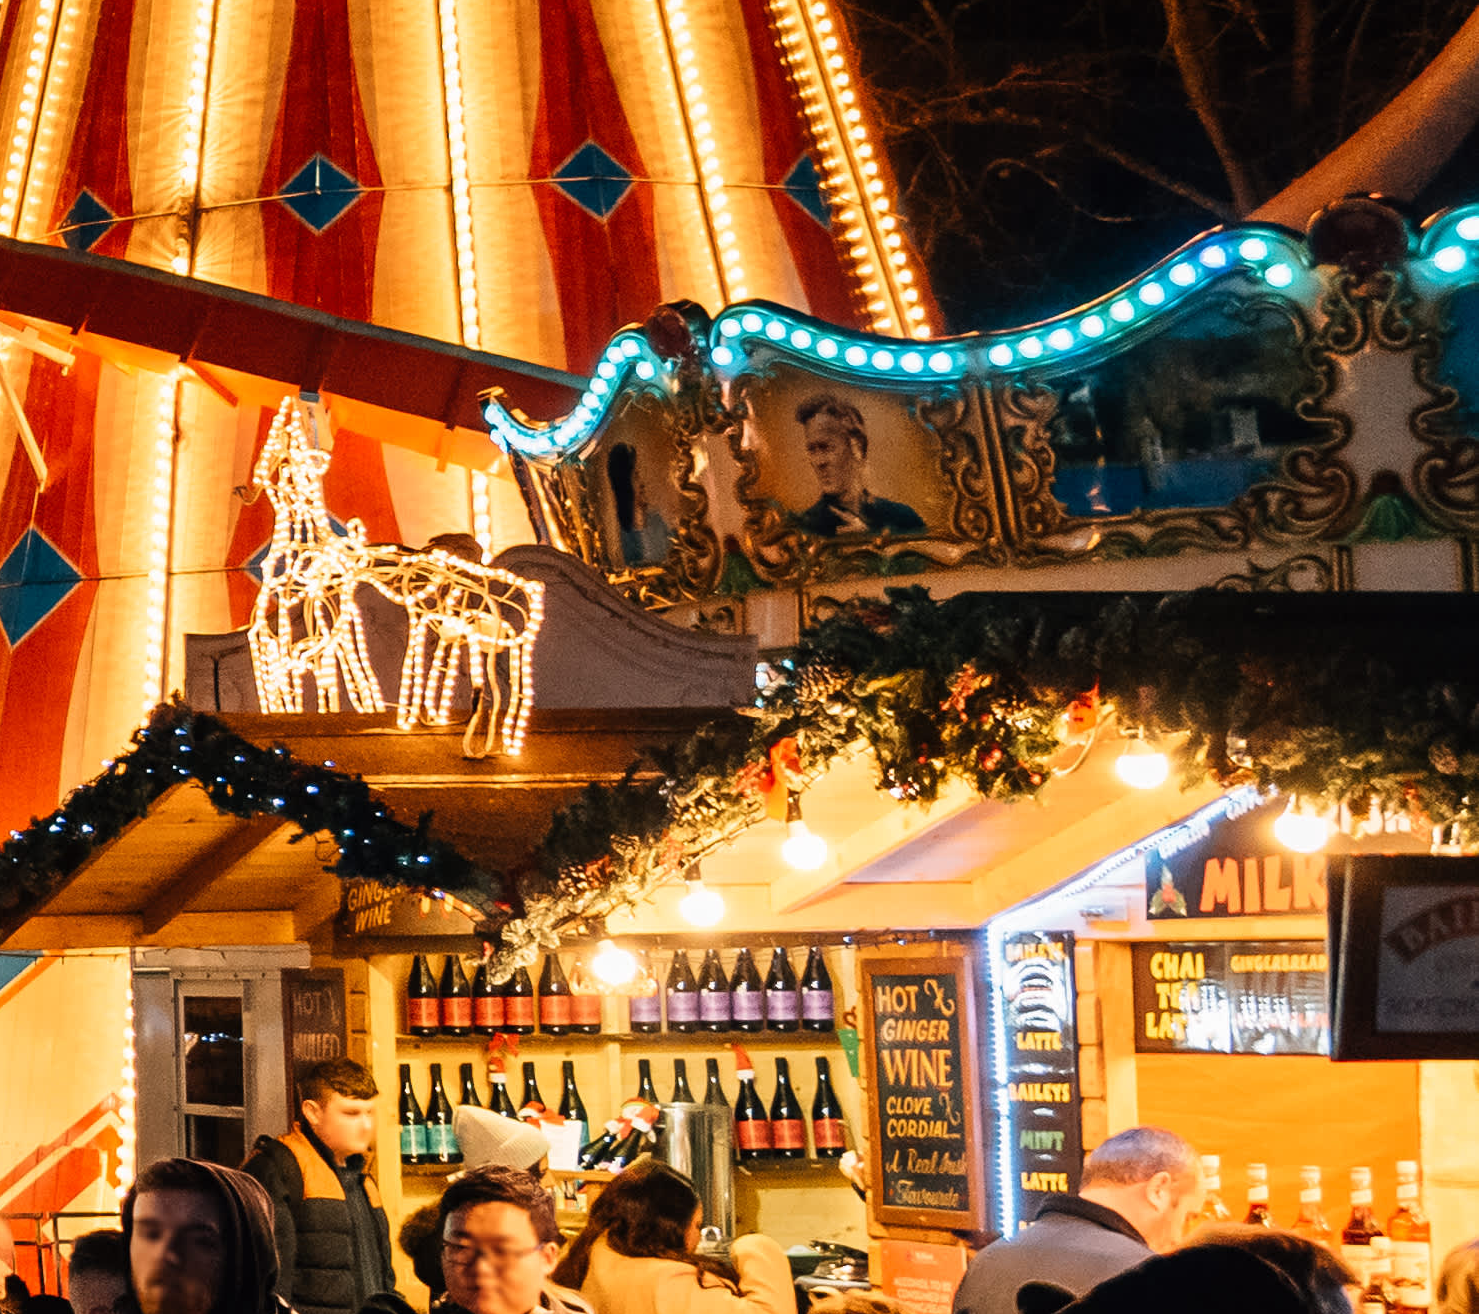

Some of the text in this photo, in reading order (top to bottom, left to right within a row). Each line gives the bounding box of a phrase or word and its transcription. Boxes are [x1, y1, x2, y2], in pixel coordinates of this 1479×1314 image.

[355, 901, 392, 933] WINE
[1150, 952, 1204, 979] CHAI
[293, 992, 320, 1015] HOT
[877, 985, 918, 1013] HOT
[881, 1019, 949, 1042] GINGER
[1145, 1012, 1187, 1040] LAT
[1017, 1032, 1062, 1051] LATTE
[881, 1049, 953, 1088] WINE
[1009, 1082, 1070, 1103] BAILEYS
[886, 1096, 932, 1116] CLOVE
[1020, 1131, 1064, 1150] MINT
[907, 1148, 938, 1174] Real
[1021, 1172, 1067, 1192] LATTE
